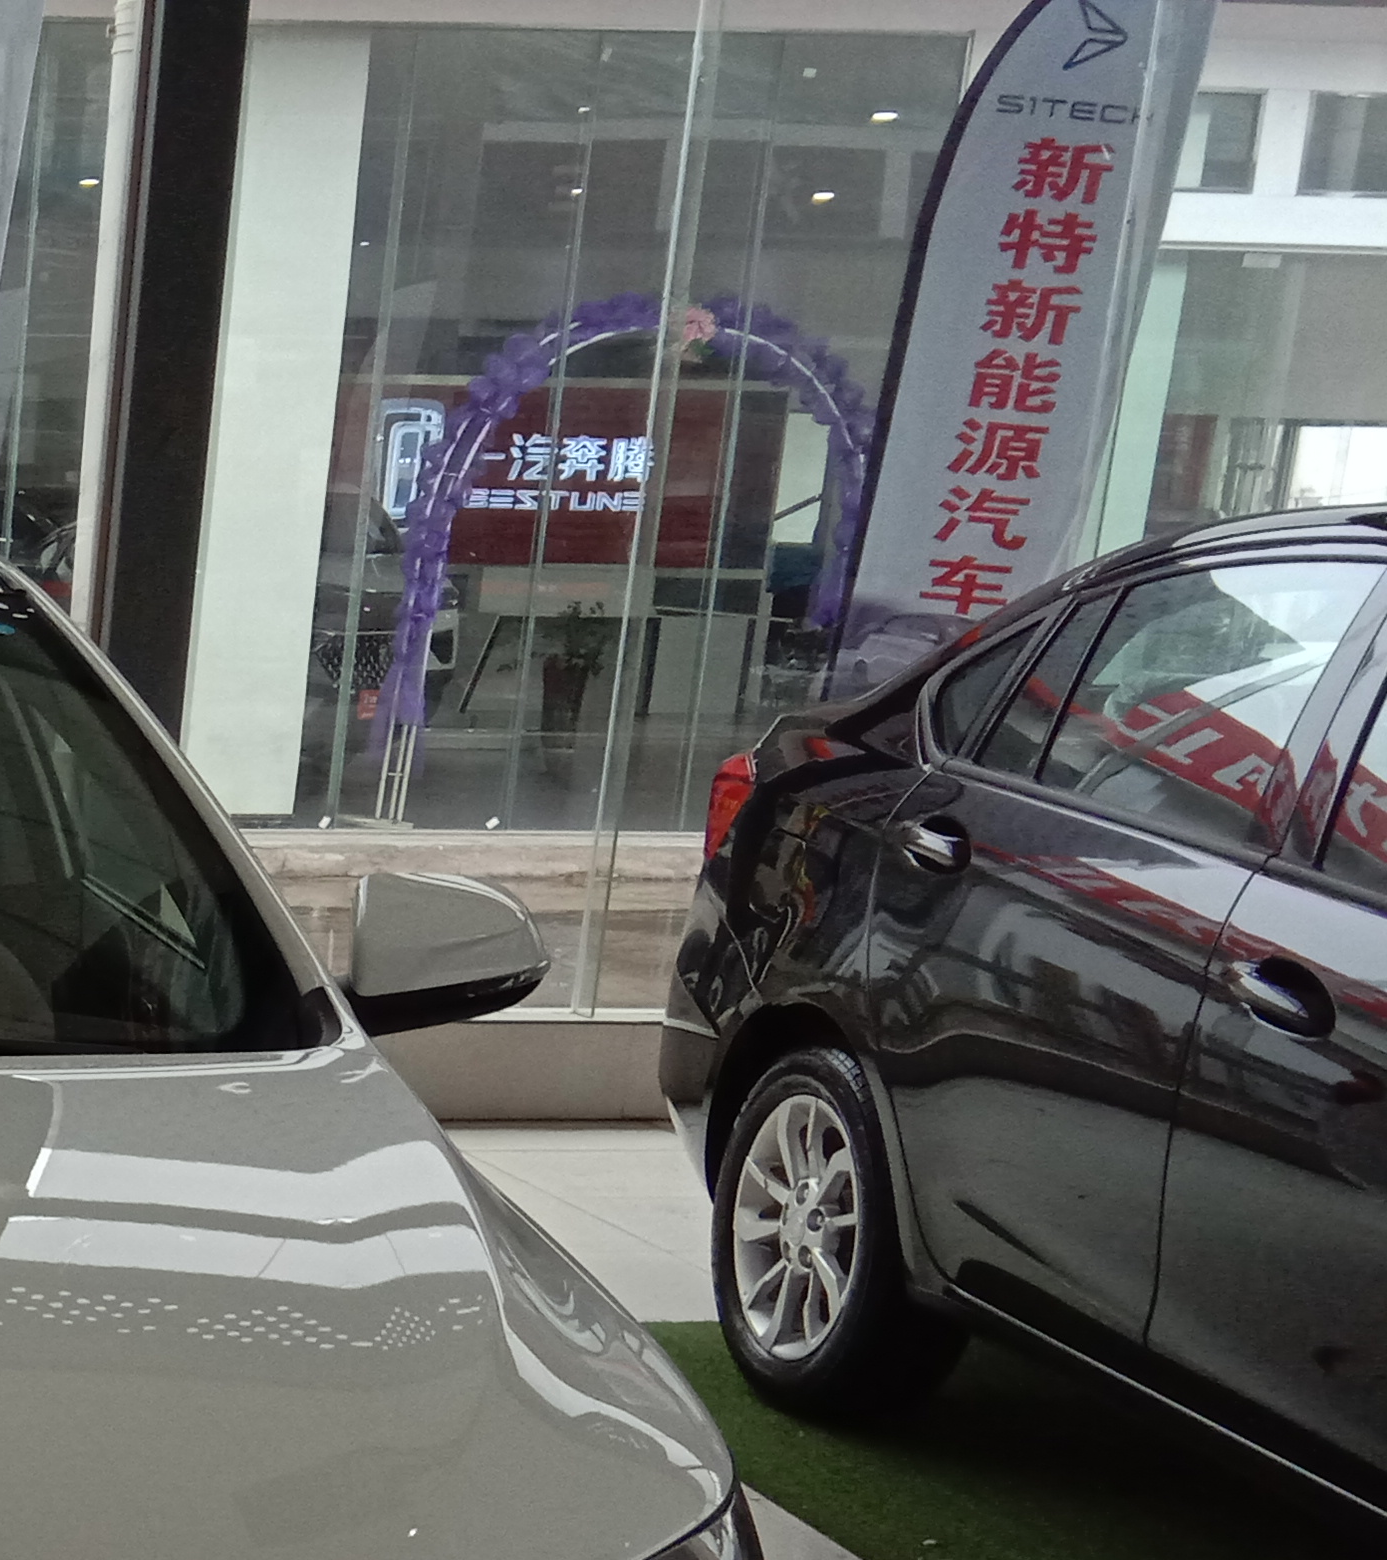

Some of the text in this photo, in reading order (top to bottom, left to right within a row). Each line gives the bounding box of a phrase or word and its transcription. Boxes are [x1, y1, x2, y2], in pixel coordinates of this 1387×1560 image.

[919, 137, 1115, 614] 新特新能源汽车
